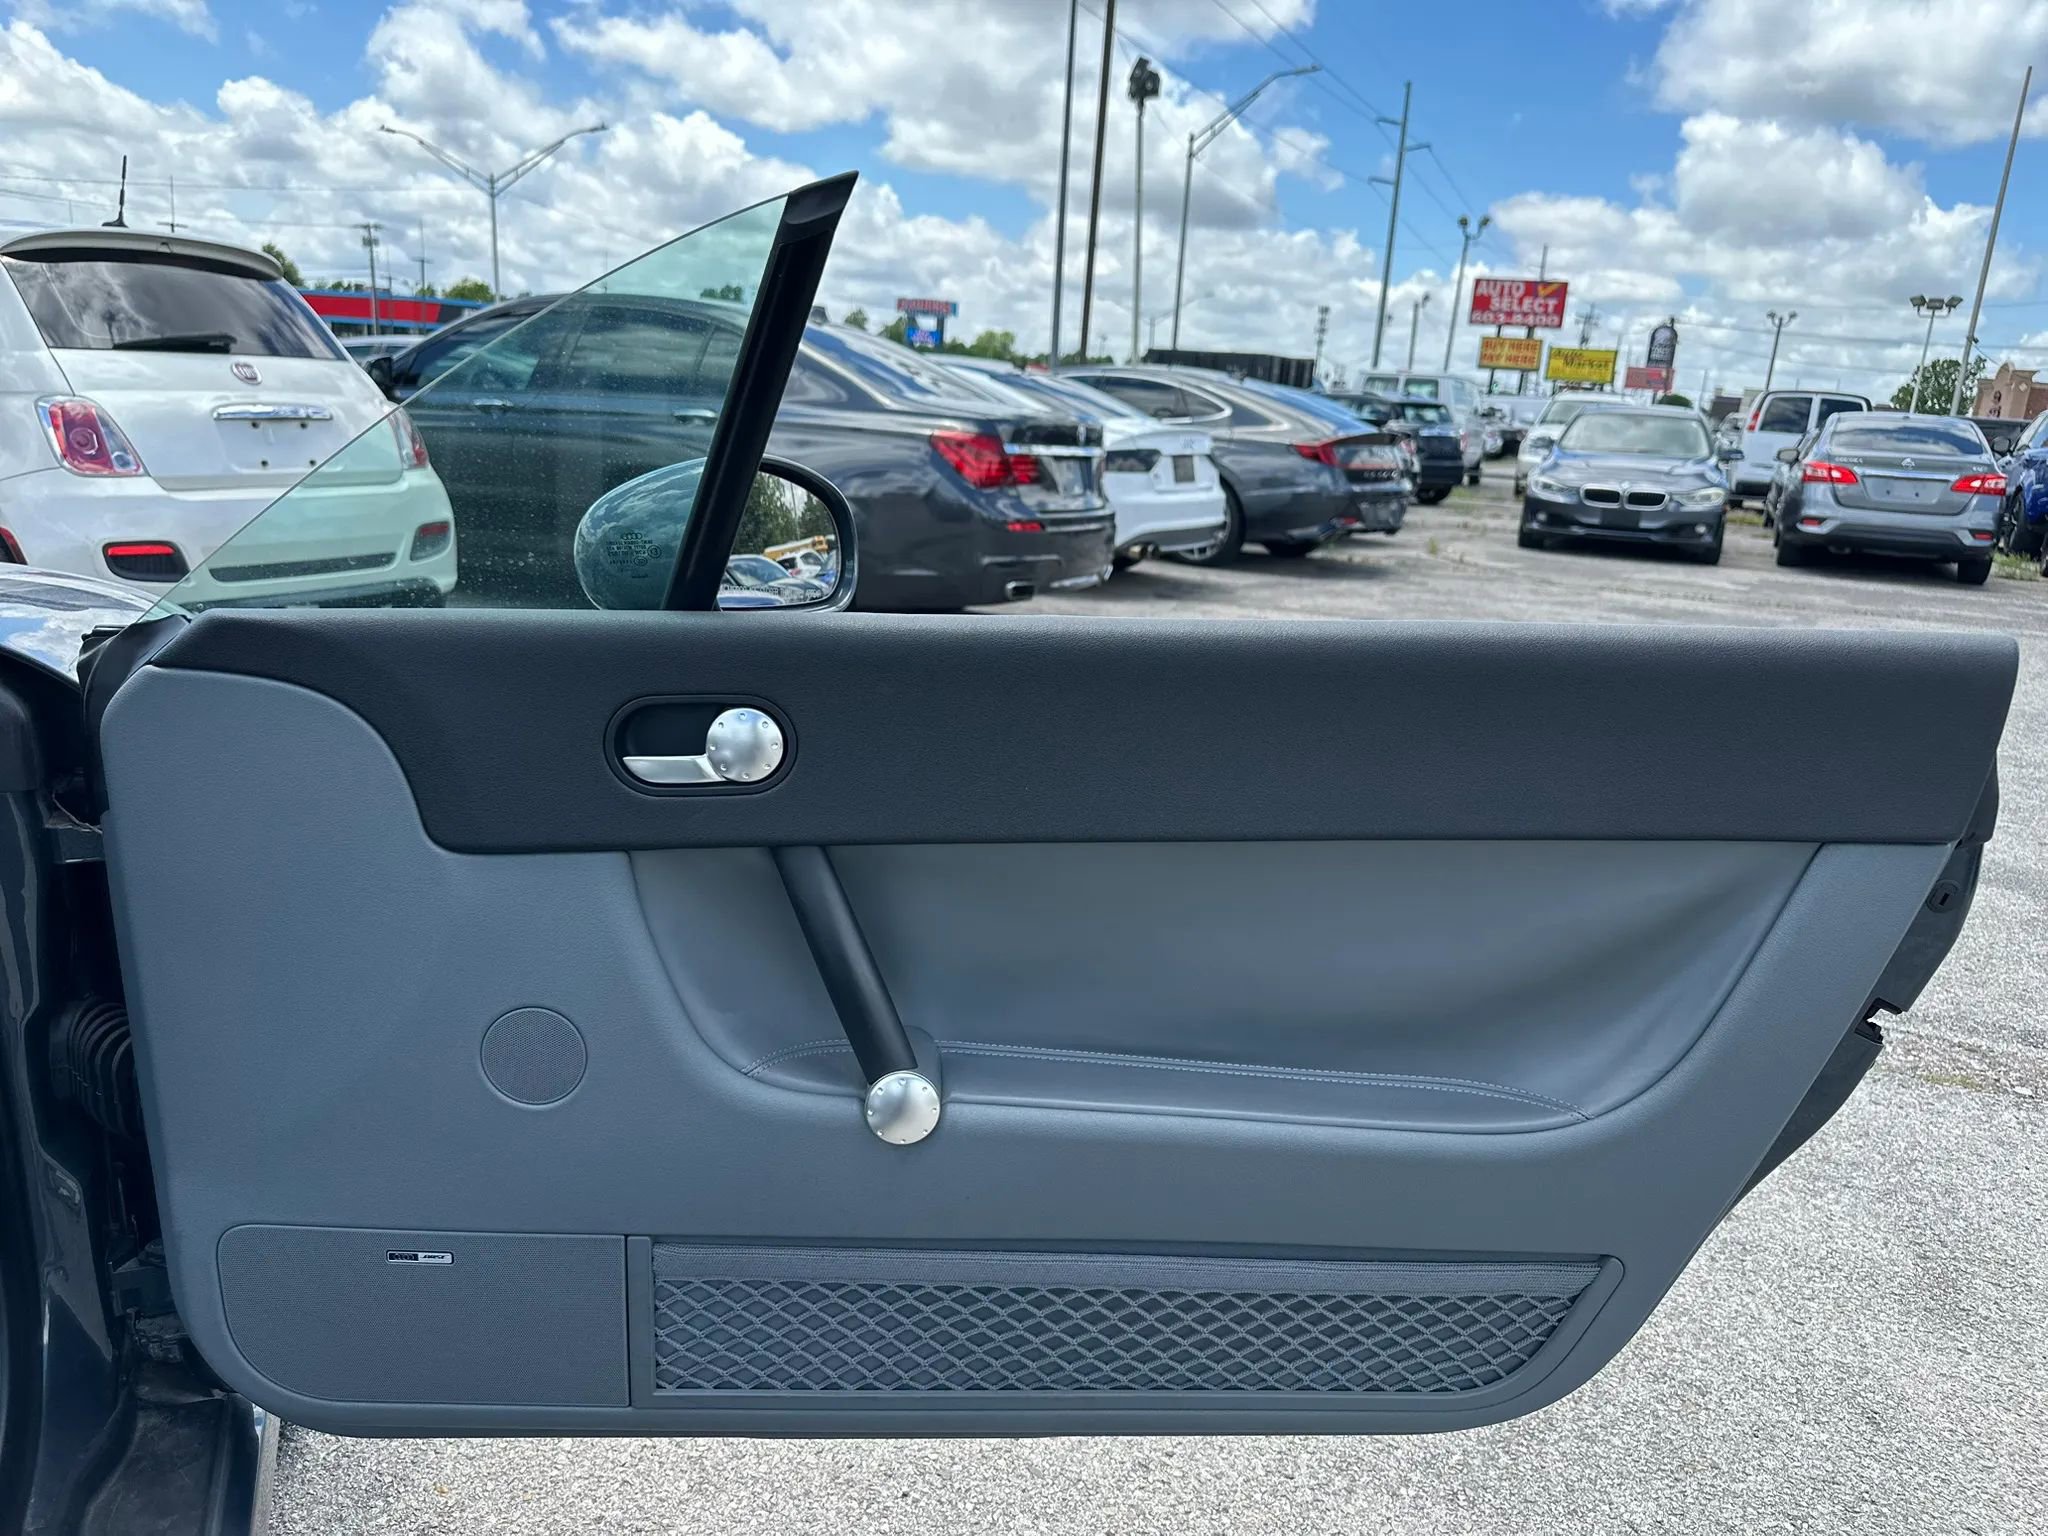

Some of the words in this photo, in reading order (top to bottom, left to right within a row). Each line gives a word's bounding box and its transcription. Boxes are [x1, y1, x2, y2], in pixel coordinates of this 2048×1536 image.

[1476, 281, 1524, 297] AUTO
[1489, 296, 1559, 313] SELECT
[1509, 340, 1539, 352] HERE
[1508, 353, 1537, 365] HERE
